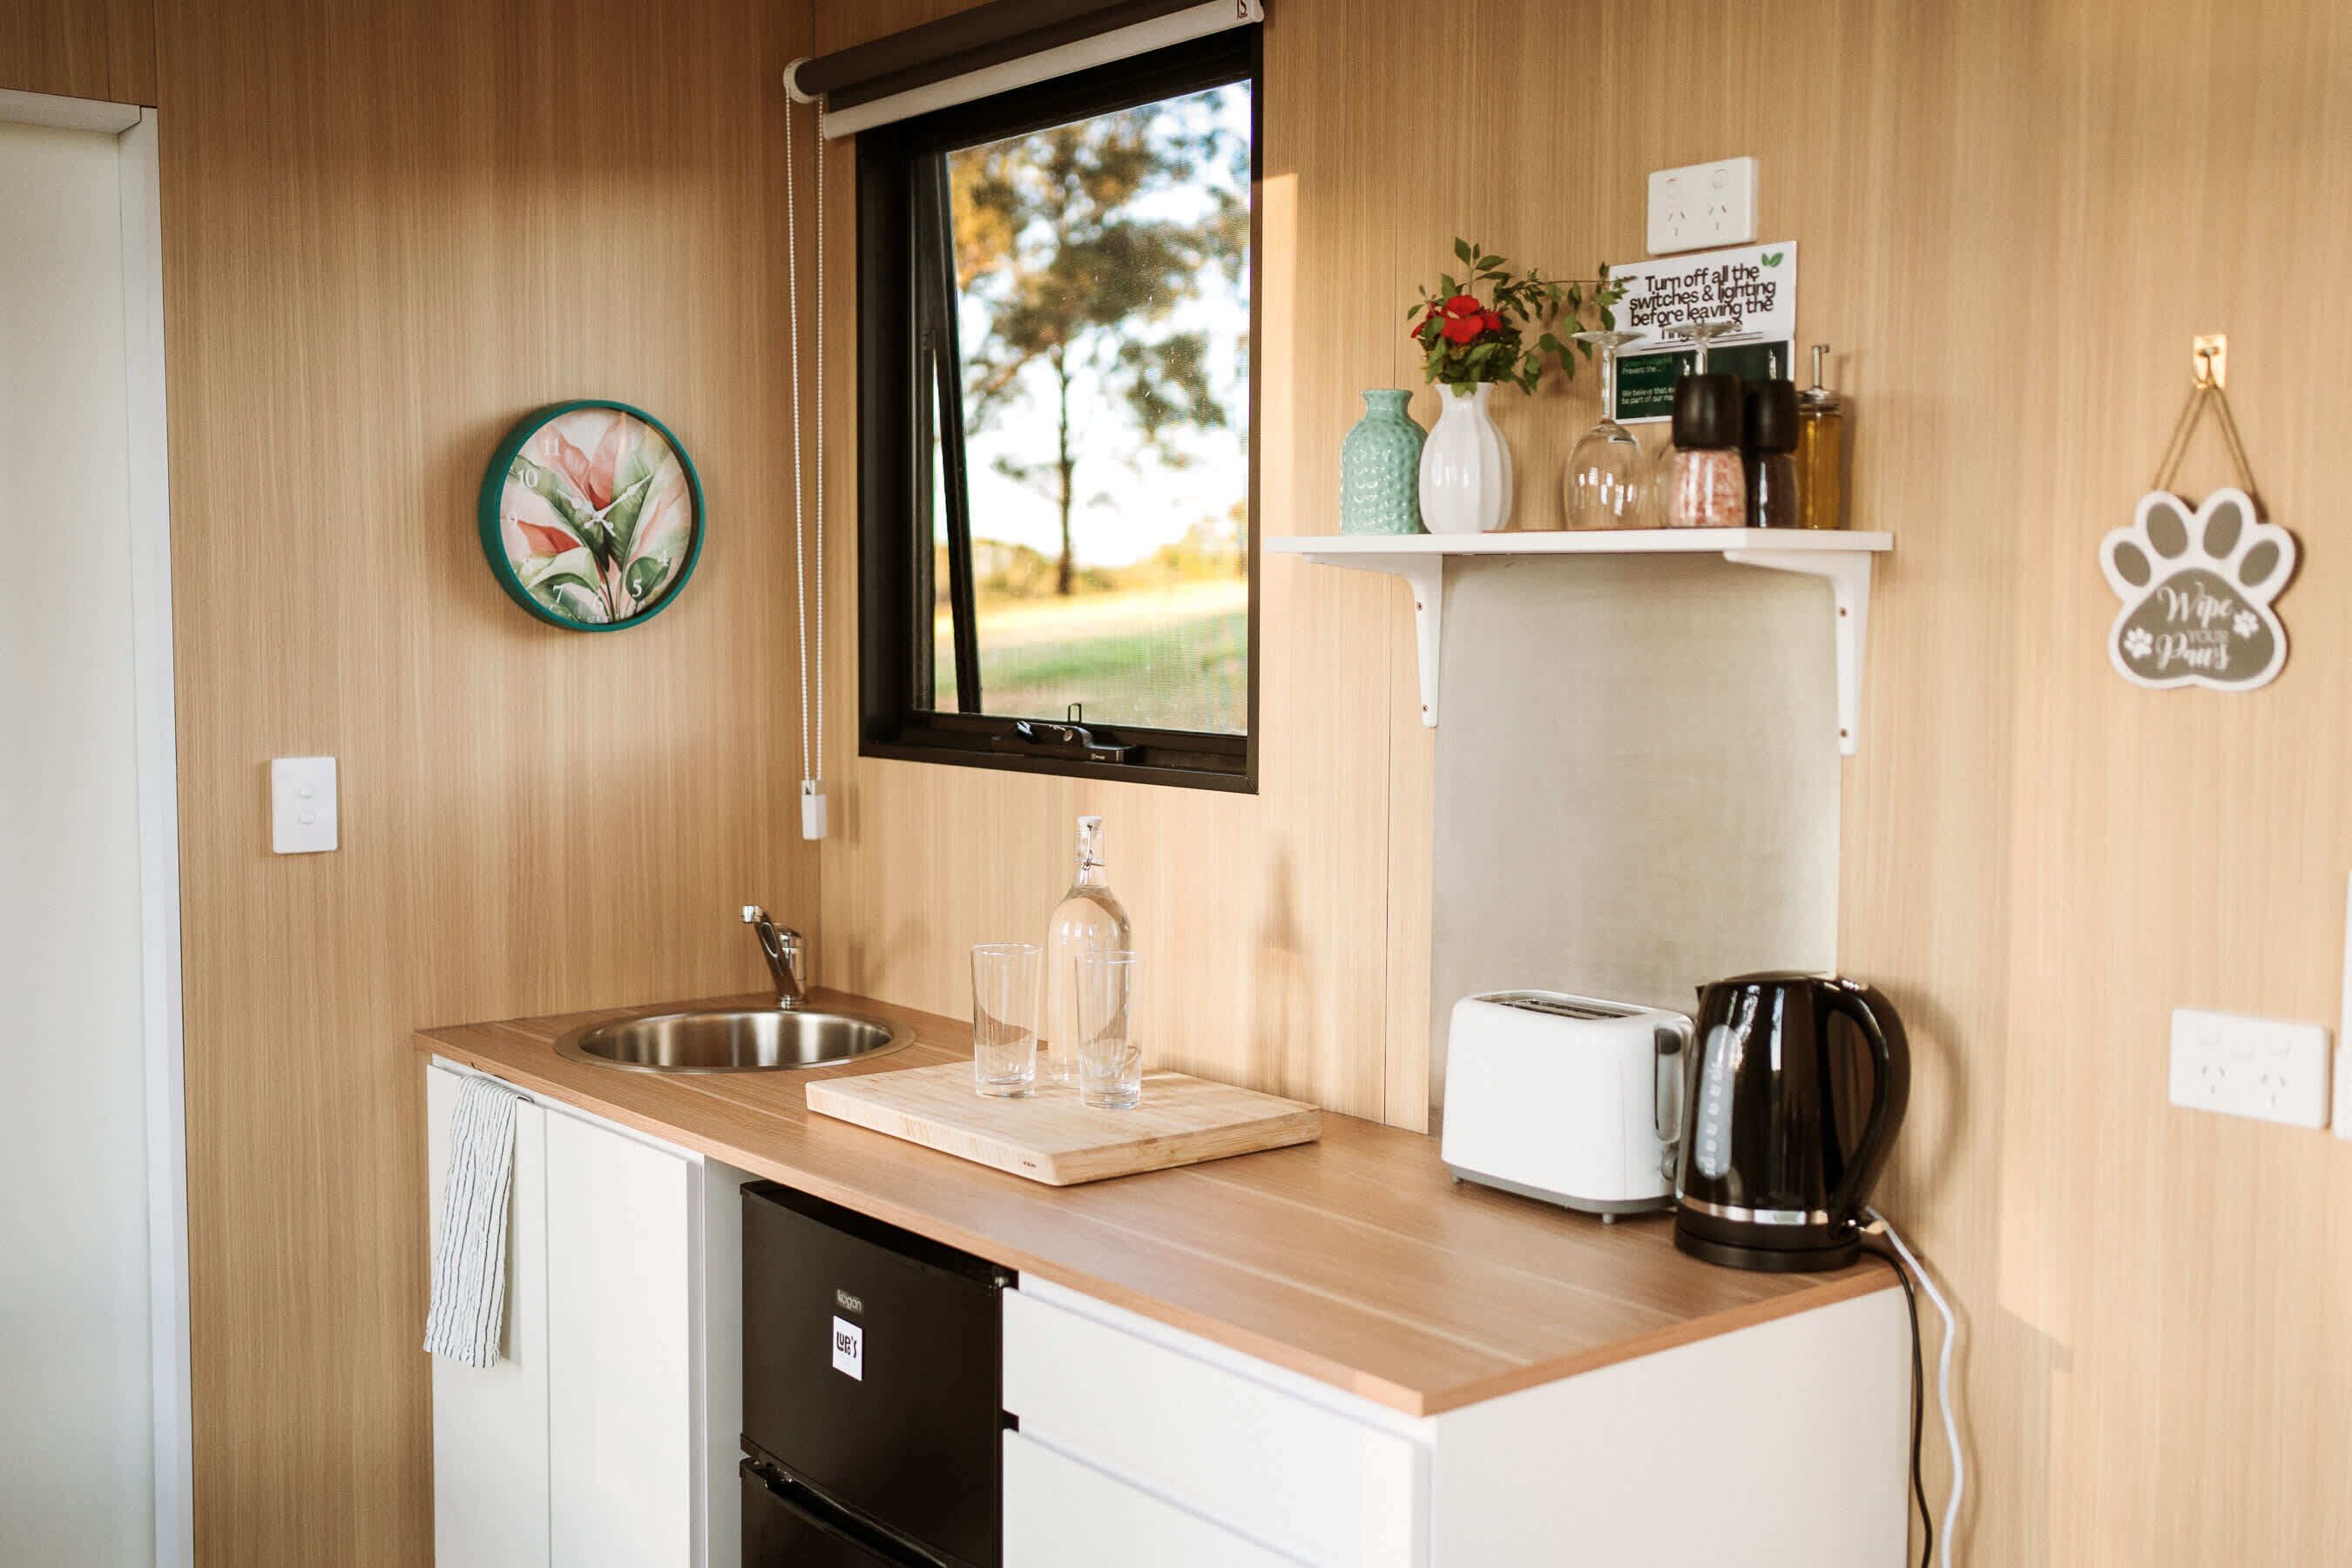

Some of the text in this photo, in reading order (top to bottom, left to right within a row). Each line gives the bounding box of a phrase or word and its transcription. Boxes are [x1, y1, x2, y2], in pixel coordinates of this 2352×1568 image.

[1645, 263, 1760, 292] Turn off all the
[1630, 279, 1776, 311] switches & lighting
[1630, 306, 1684, 328] before
[1686, 302, 1742, 325] leaving
[1745, 295, 1774, 314] the
[517, 468, 538, 488] 10
[551, 585, 564, 604] 7
[632, 578, 643, 598] 5
[2156, 579, 2234, 629] Wipe
[836, 1289, 862, 1311] kogan
